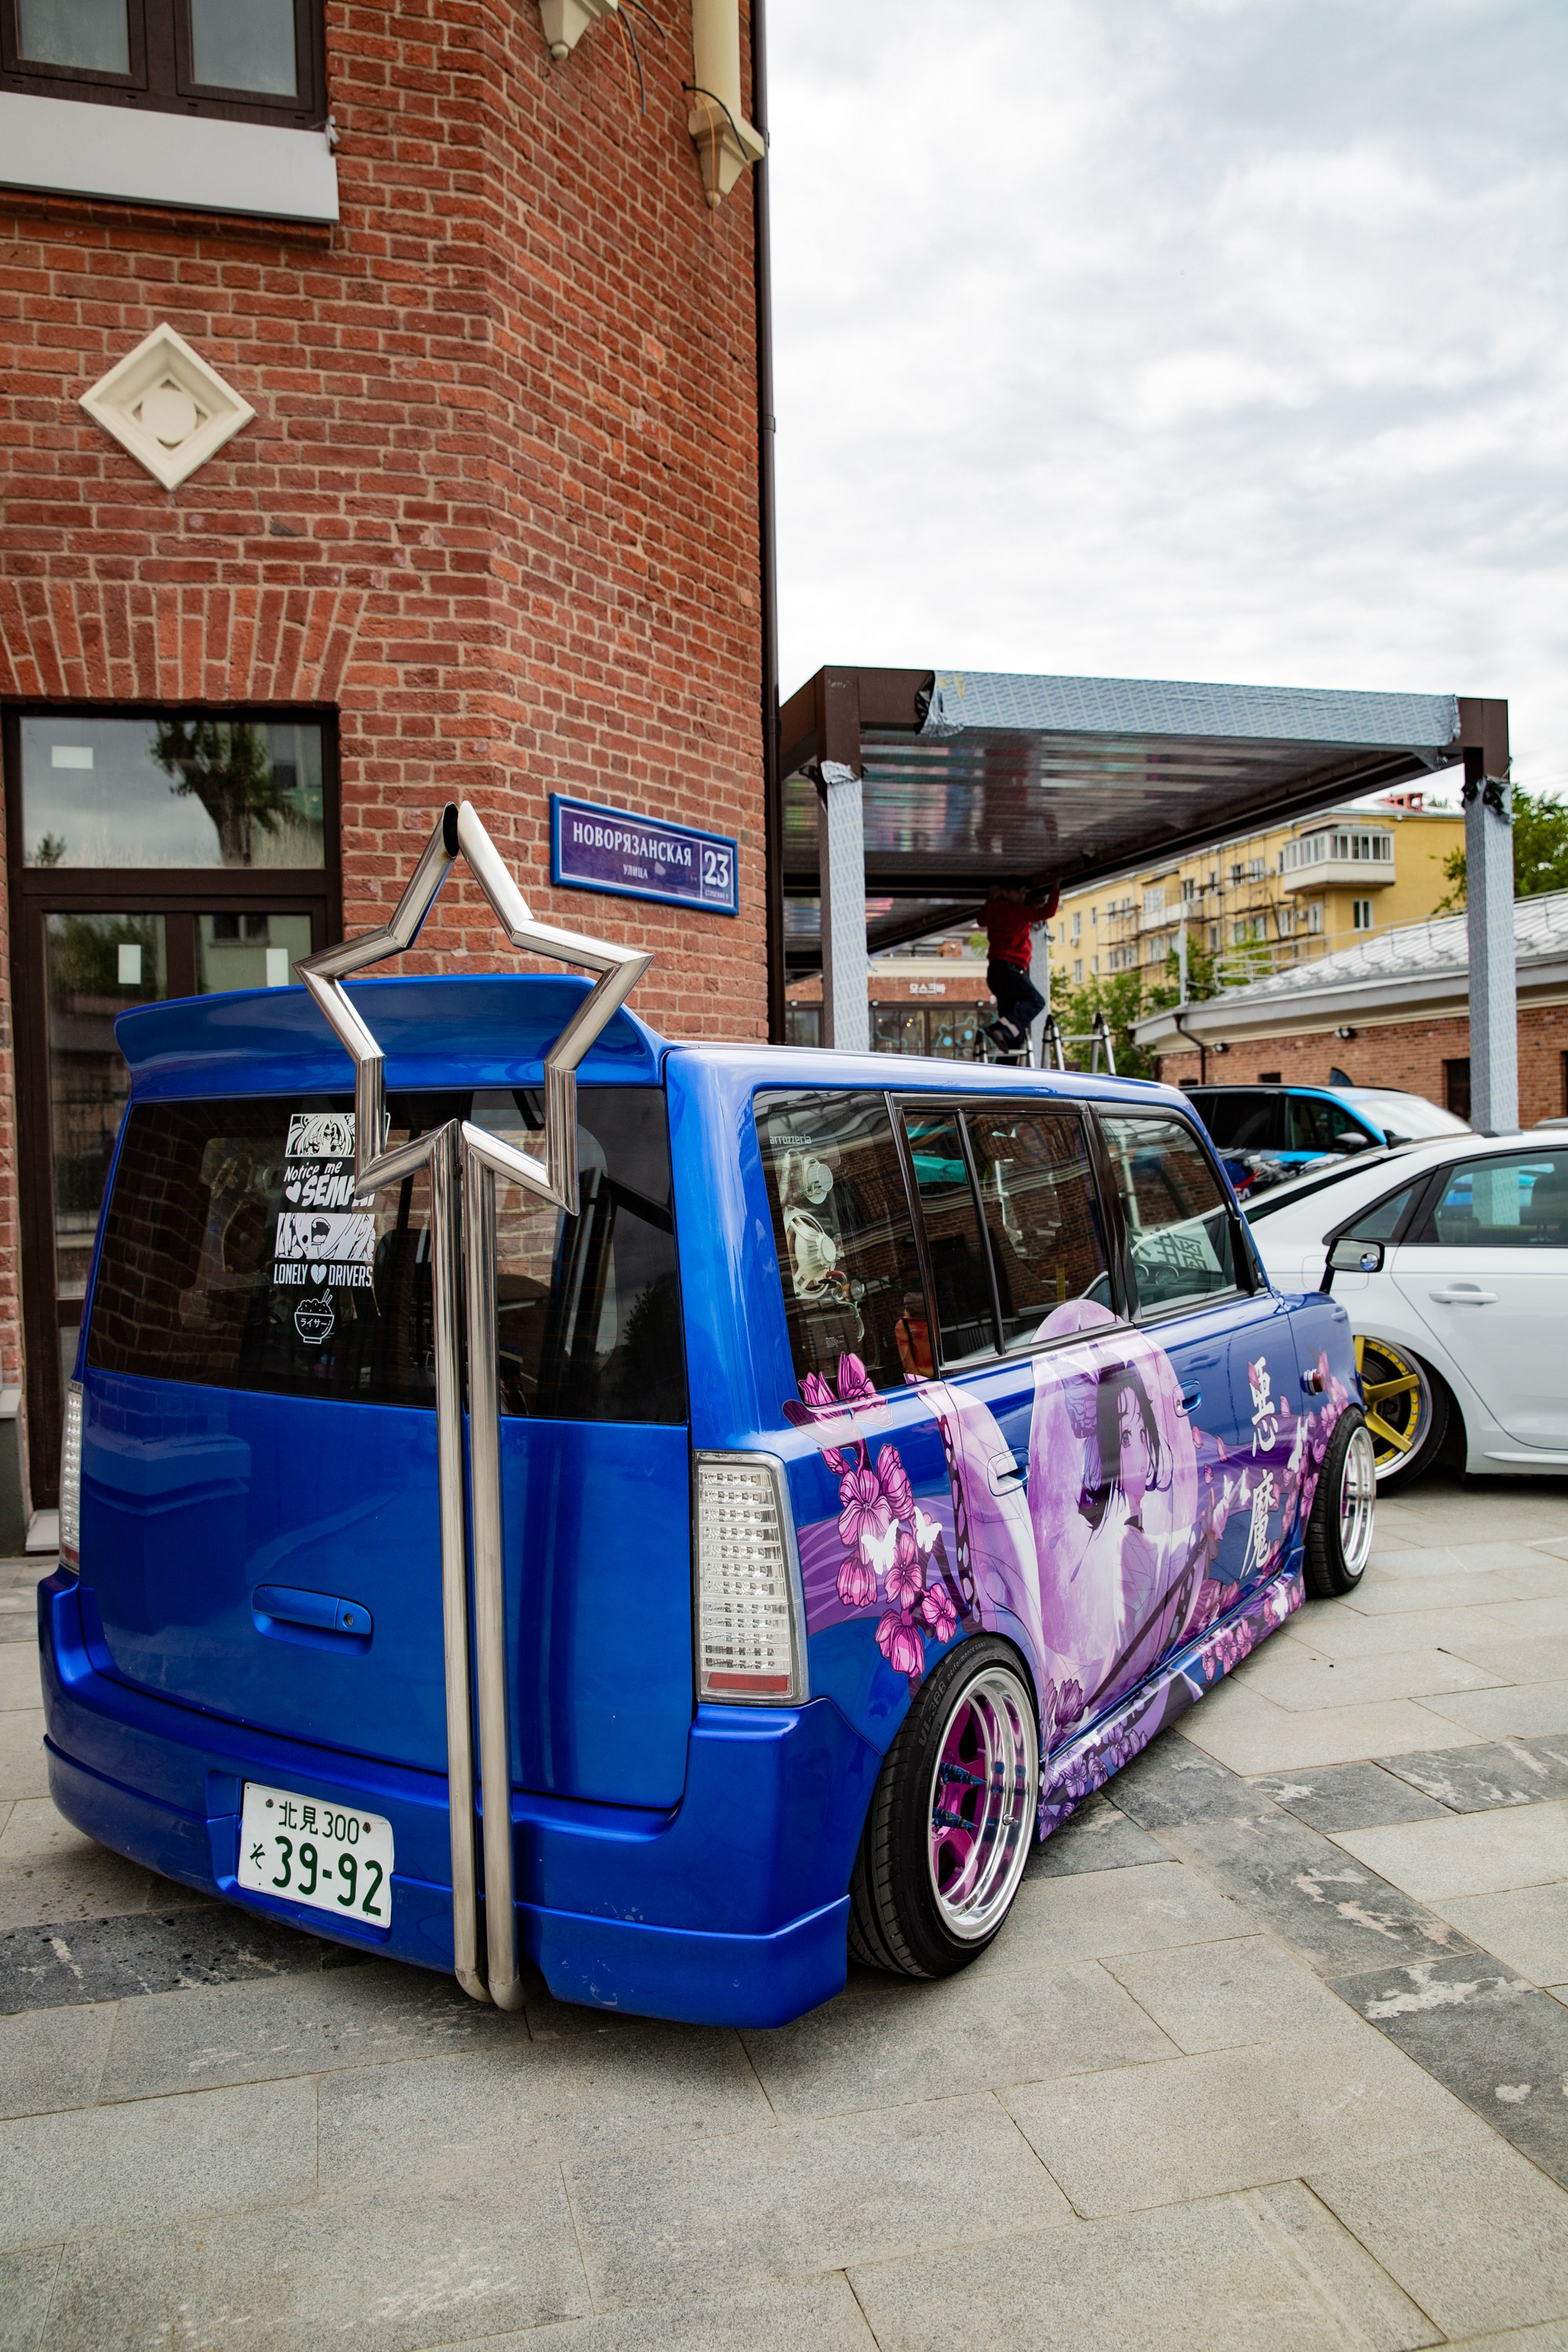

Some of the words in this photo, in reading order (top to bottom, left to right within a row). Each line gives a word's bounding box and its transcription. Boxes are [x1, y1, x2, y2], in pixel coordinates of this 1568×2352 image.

[573, 822, 691, 867] НОВОРЯЗАНСКАЯ
[623, 864, 648, 880] УЛИЦА
[704, 850, 729, 887] 23
[769, 1134, 812, 1145] arrozzeria
[283, 1162, 320, 1182] Notice
[324, 1161, 343, 1174] me
[301, 1174, 376, 1208] SEMP
[274, 1264, 309, 1285] LONELY
[328, 1265, 373, 1287] DRIVERS
[300, 1318, 328, 1328] ライサー
[918, 1680, 946, 1747] VI-388
[947, 1647, 975, 1682] performance
[278, 1800, 318, 1835] 北見
[321, 1810, 360, 1845] 300
[249, 1842, 266, 1870] そ
[271, 1835, 383, 1917] 39-92
